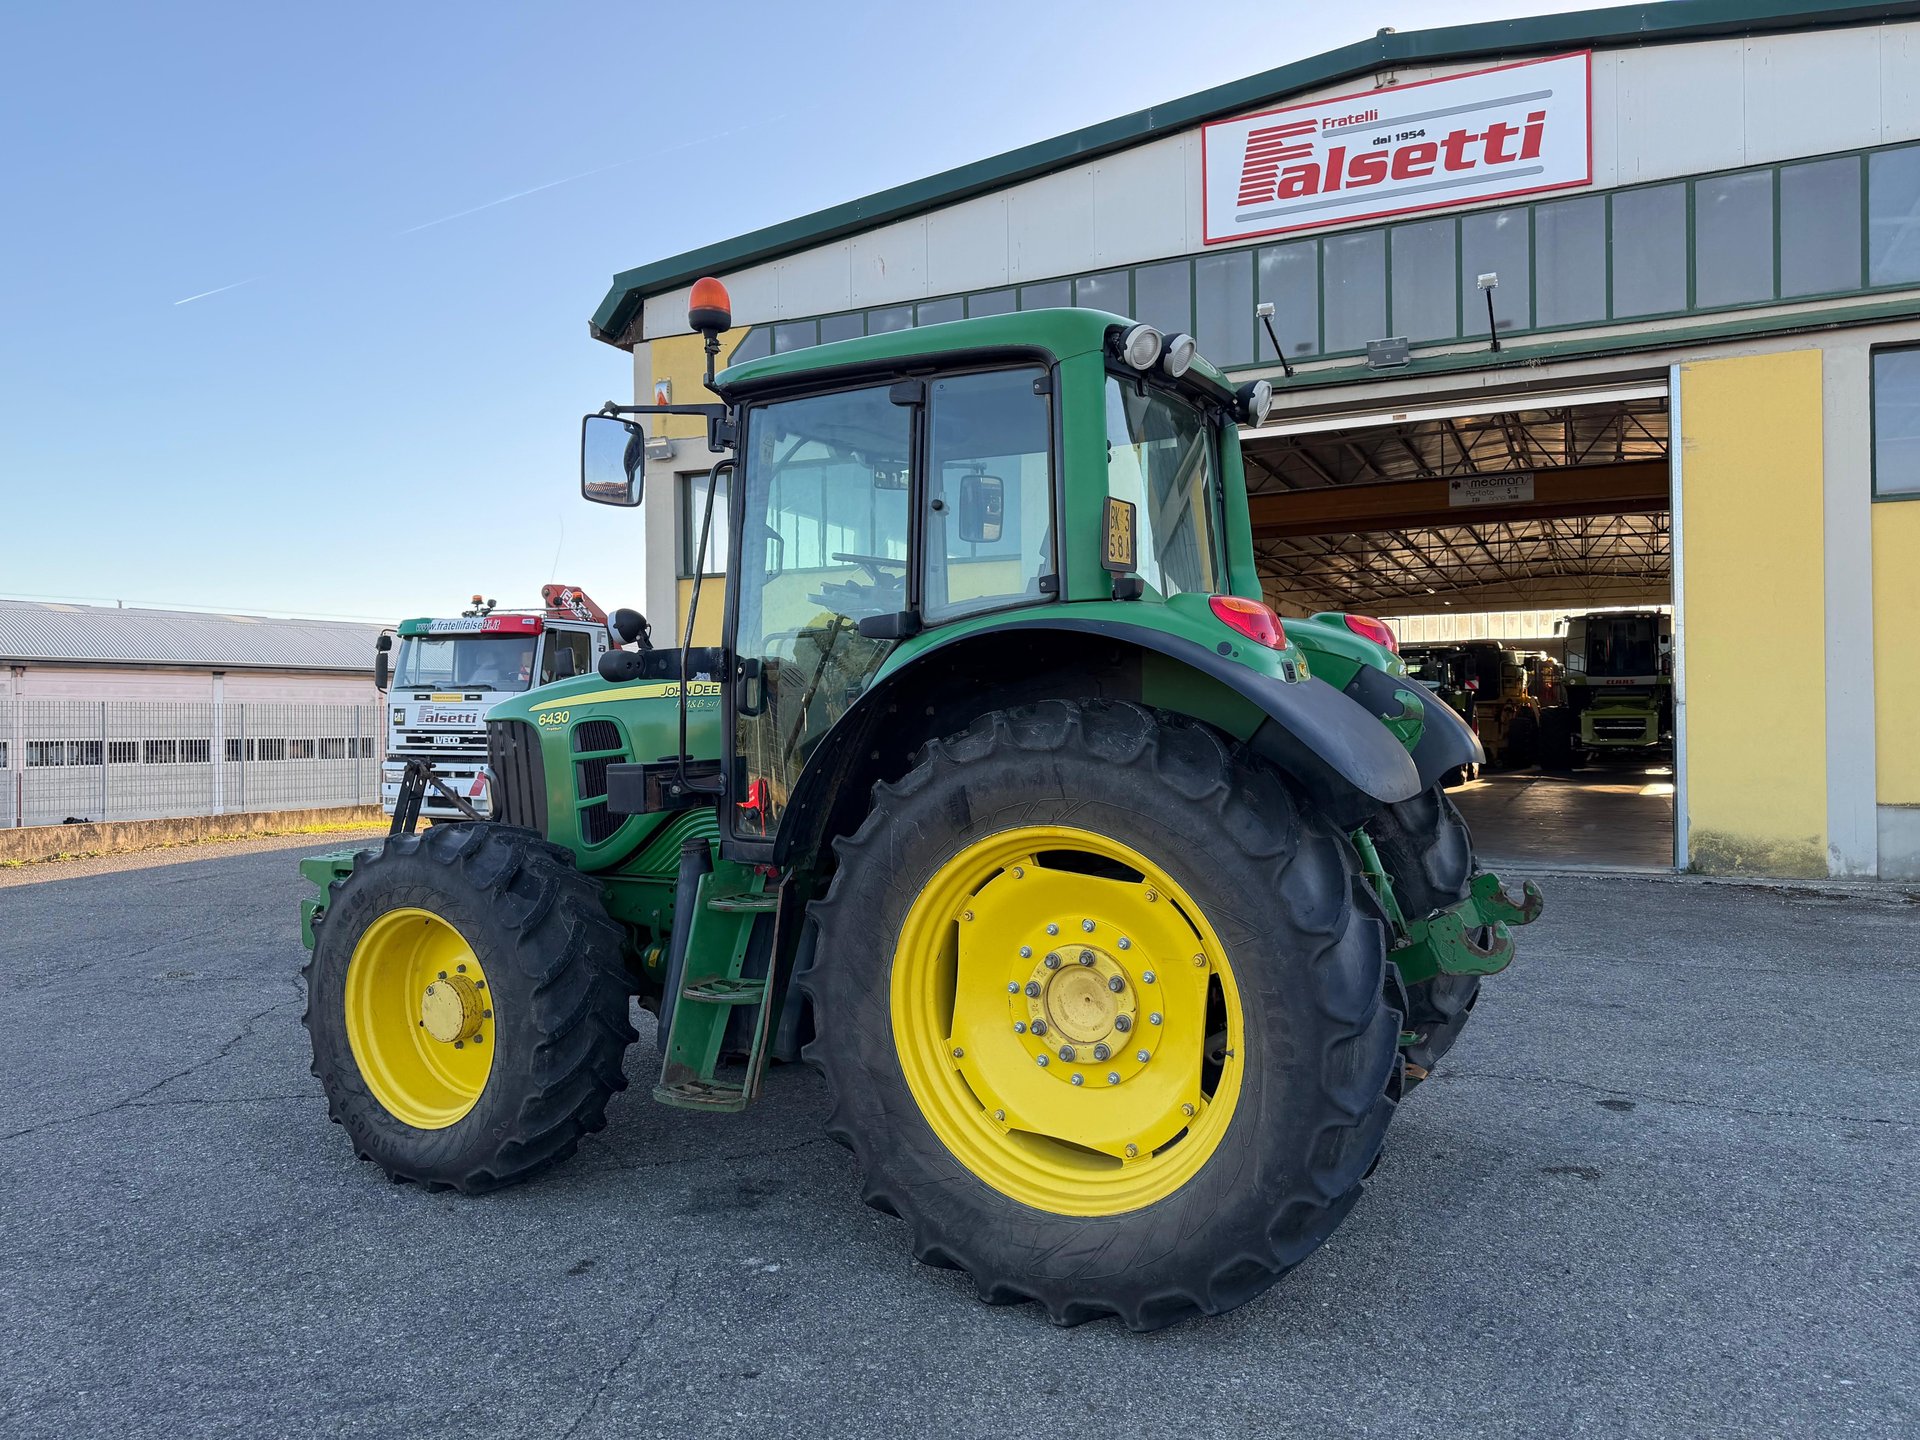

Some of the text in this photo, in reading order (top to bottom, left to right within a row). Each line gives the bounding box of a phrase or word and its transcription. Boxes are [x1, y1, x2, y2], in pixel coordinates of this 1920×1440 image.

[1321, 109, 1379, 129] Fratelli
[1372, 128, 1426, 146] dal 1954
[1236, 110, 1547, 207] Falsetti
[415, 619, 501, 632] www.fratellifalsetti.it
[693, 683, 722, 695] DEE
[538, 710, 571, 727] 6430
[433, 736, 460, 745] IVECO
